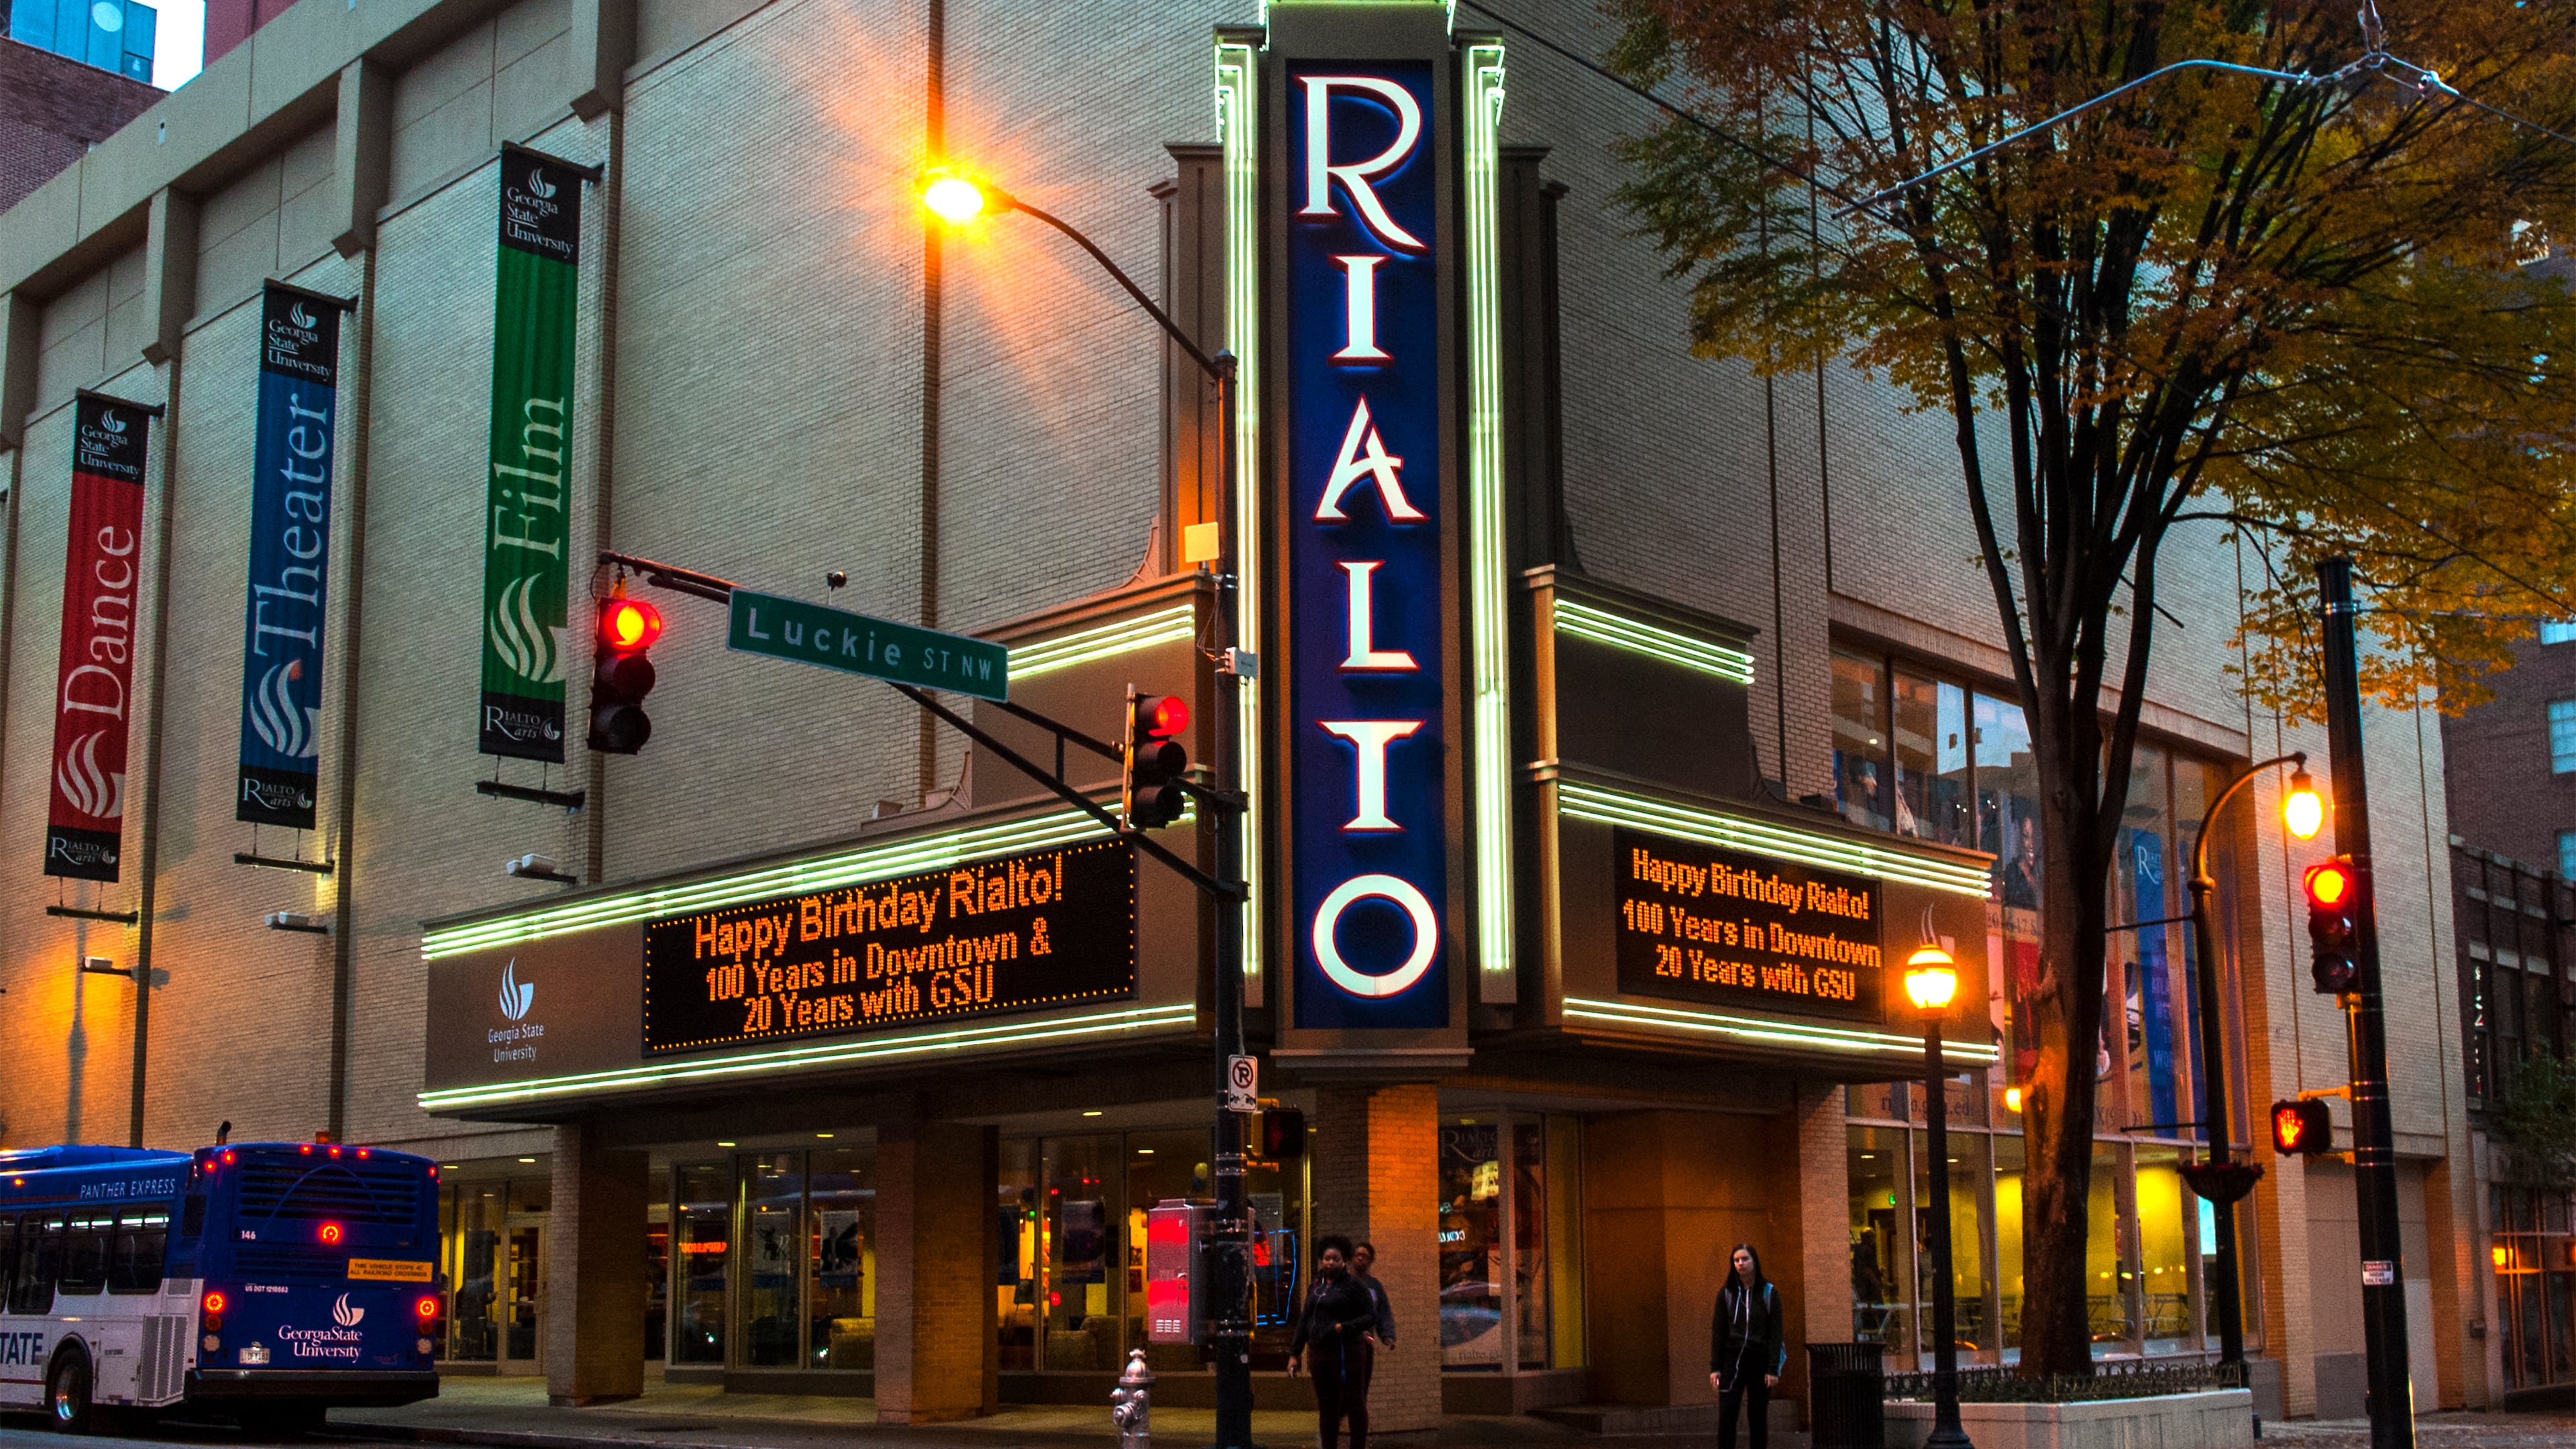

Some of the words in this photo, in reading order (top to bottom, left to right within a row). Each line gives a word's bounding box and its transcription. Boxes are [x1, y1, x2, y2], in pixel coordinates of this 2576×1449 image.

[507, 187, 559, 217] Georgia
[507, 203, 538, 224] State
[507, 222, 574, 259] University
[269, 319, 319, 345] Georgia
[269, 333, 299, 352] State
[268, 350, 333, 382] University
[81, 424, 128, 448] Georgia
[81, 437, 109, 453] State
[80, 452, 140, 480] University
[493, 396, 564, 561] Film
[253, 392, 327, 657] Theater
[1295, 74, 1438, 999] RIALTO
[64, 525, 134, 722] Dance
[748, 607, 902, 665] Luckie
[923, 647, 951, 673] ST
[962, 655, 991, 681] NW
[484, 704, 540, 741] RIALTO
[514, 728, 537, 738] arts
[242, 777, 295, 810] RIALTO
[270, 798, 291, 807] arts
[50, 837, 100, 865] RIALTO
[76, 853, 96, 863] arts
[1632, 847, 1707, 898] Happy
[1711, 862, 1804, 914] Birthday
[1807, 880, 1870, 920] Rialto!
[694, 912, 793, 960] Happy
[799, 886, 941, 943] Birthday
[949, 854, 1063, 919] Rialto!
[1622, 898, 1664, 934] 100
[1669, 905, 1739, 947] Years
[1743, 918, 1764, 951] in
[1769, 921, 1882, 968] Downtown
[706, 962, 745, 1002] 100
[752, 955, 824, 994] Years
[833, 949, 857, 984] in
[866, 930, 1018, 980] Downtown
[1030, 916, 1053, 956] &
[1655, 943, 1682, 978] 20
[1688, 948, 1756, 988] Years
[1761, 962, 1809, 995] with
[1813, 967, 1856, 1001] GSU
[743, 996, 773, 1034] 20
[780, 990, 855, 1028] Years
[860, 976, 920, 1020] with
[929, 963, 994, 1008] GSU
[488, 1026, 520, 1044] Georgia
[522, 1023, 545, 1039] State
[493, 1044, 537, 1063] University
[80, 1181, 126, 1199] PANTHER
[130, 1178, 176, 1197] EXPRESS
[241, 1230, 256, 1240] 146
[0, 1332, 44, 1366] TATE
[294, 1341, 362, 1364] University
